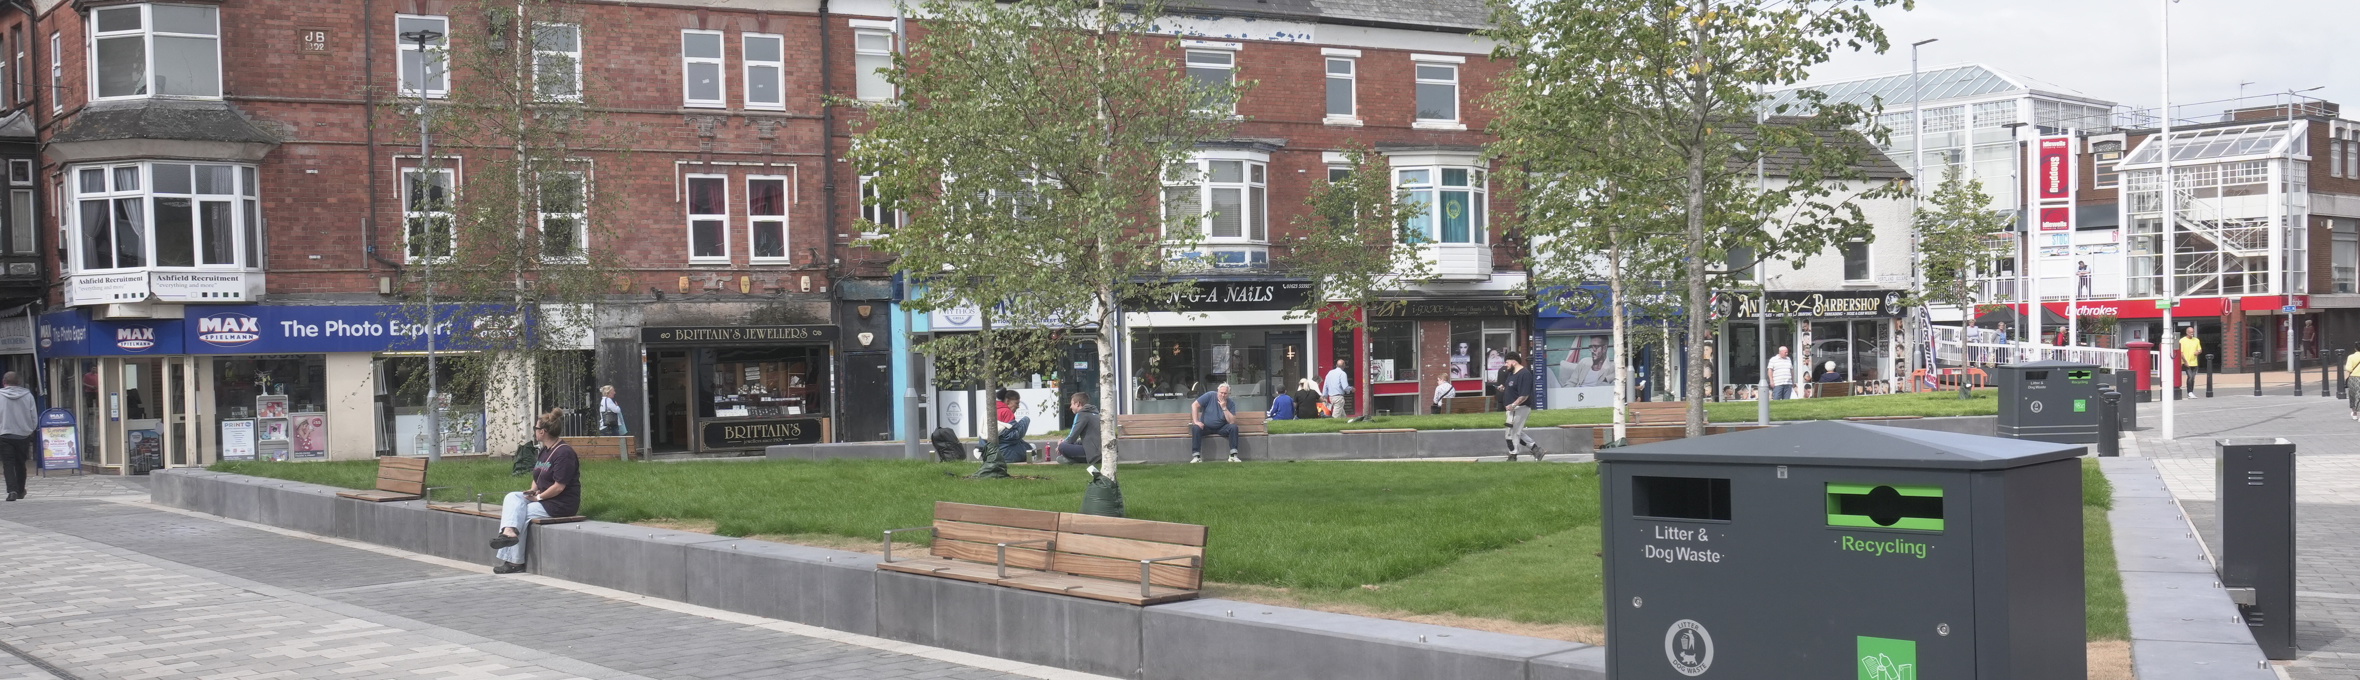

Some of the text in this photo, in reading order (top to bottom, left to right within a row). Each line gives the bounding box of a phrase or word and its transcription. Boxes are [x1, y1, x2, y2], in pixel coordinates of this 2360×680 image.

[2049, 156, 2060, 193] Shopping
[79, 275, 144, 285] Ashfield Recruitment
[1812, 293, 1881, 317] BARBERSHOP
[2065, 304, 2118, 317] Ldbrokes
[199, 317, 259, 333] MAX
[280, 320, 319, 337] The
[325, 319, 384, 337] Photo
[60, 326, 72, 342] Photo
[72, 324, 87, 344] Expert
[117, 328, 154, 340] MAX
[675, 328, 808, 341] BRITTAIN'S JEWELLERS
[724, 423, 802, 440] BRITTAIN'S
[1655, 525, 1709, 542] Litter &
[1645, 544, 1721, 563] Dog Waste
[1842, 535, 1927, 559] Recycling
[1677, 621, 1699, 631] LITTER
[1672, 659, 1707, 674] DOG WASTE
